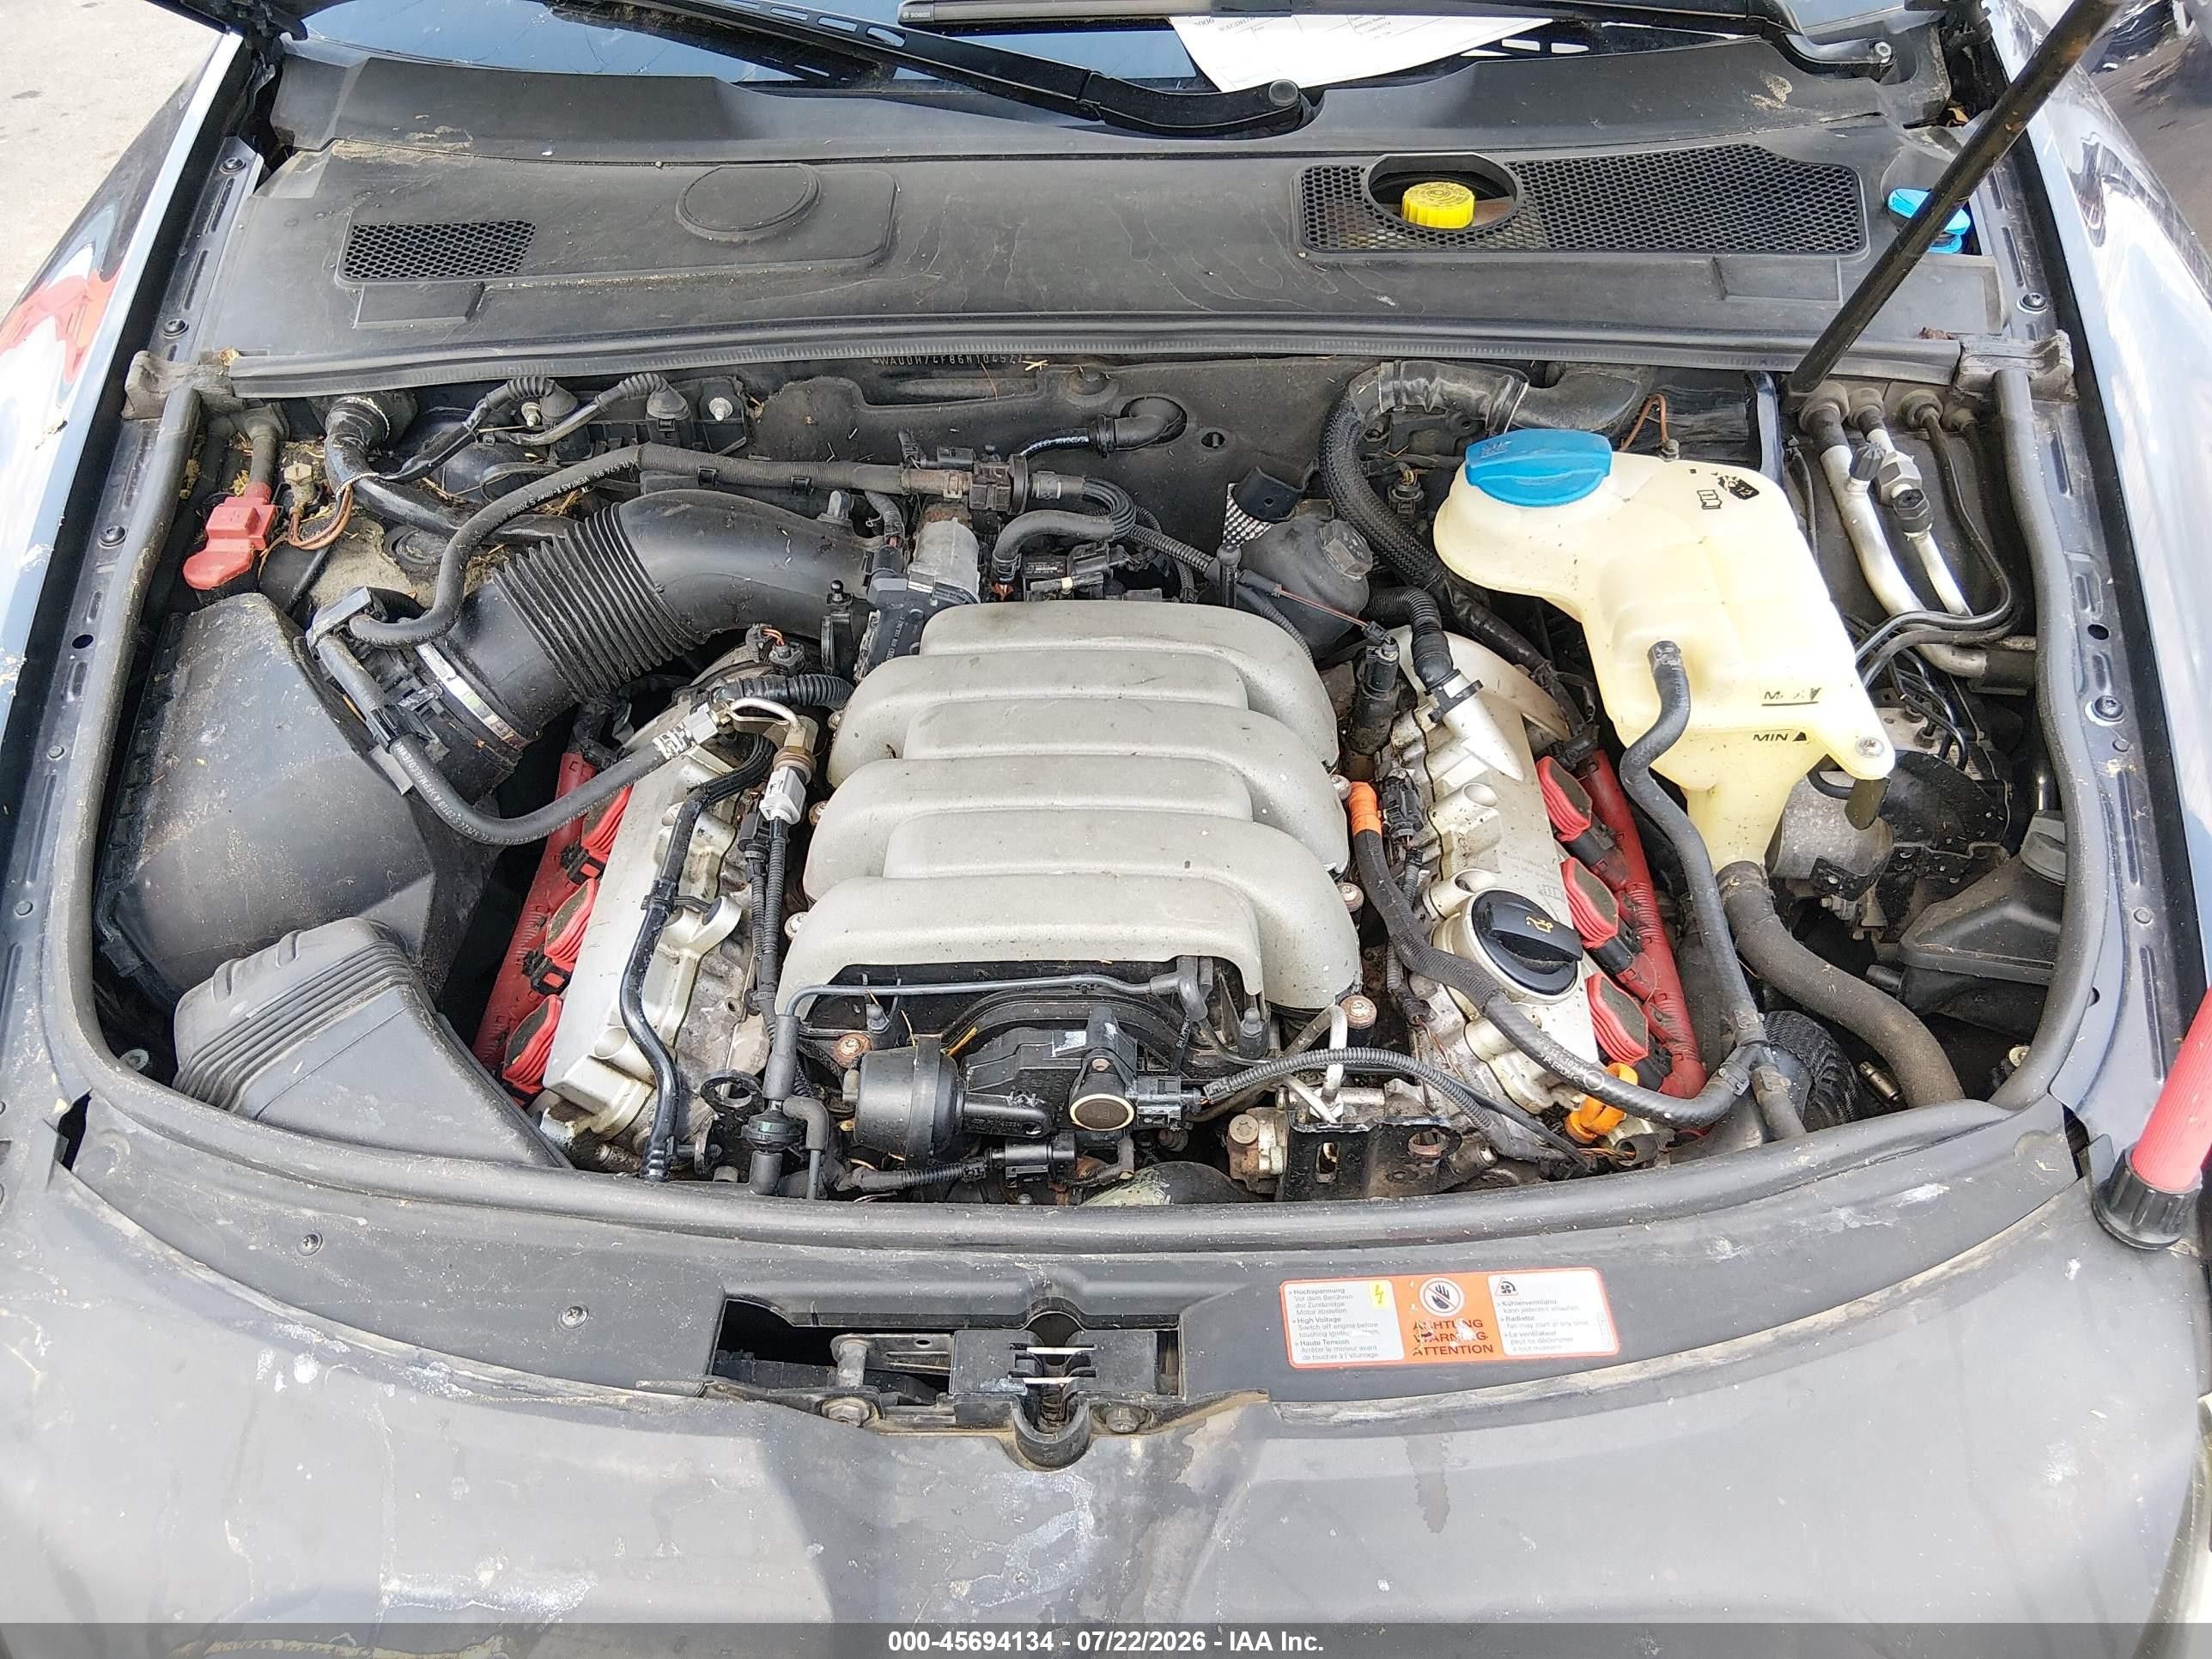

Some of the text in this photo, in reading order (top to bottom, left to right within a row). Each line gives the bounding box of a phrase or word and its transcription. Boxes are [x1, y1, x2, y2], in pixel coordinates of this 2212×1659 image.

[562, 475, 590, 492] VERITAS
[537, 485, 562, 502] X-liner
[507, 501, 529, 517] 20066
[1753, 733, 1789, 742] MIN
[1413, 1345, 1494, 1356] ATTENTION
